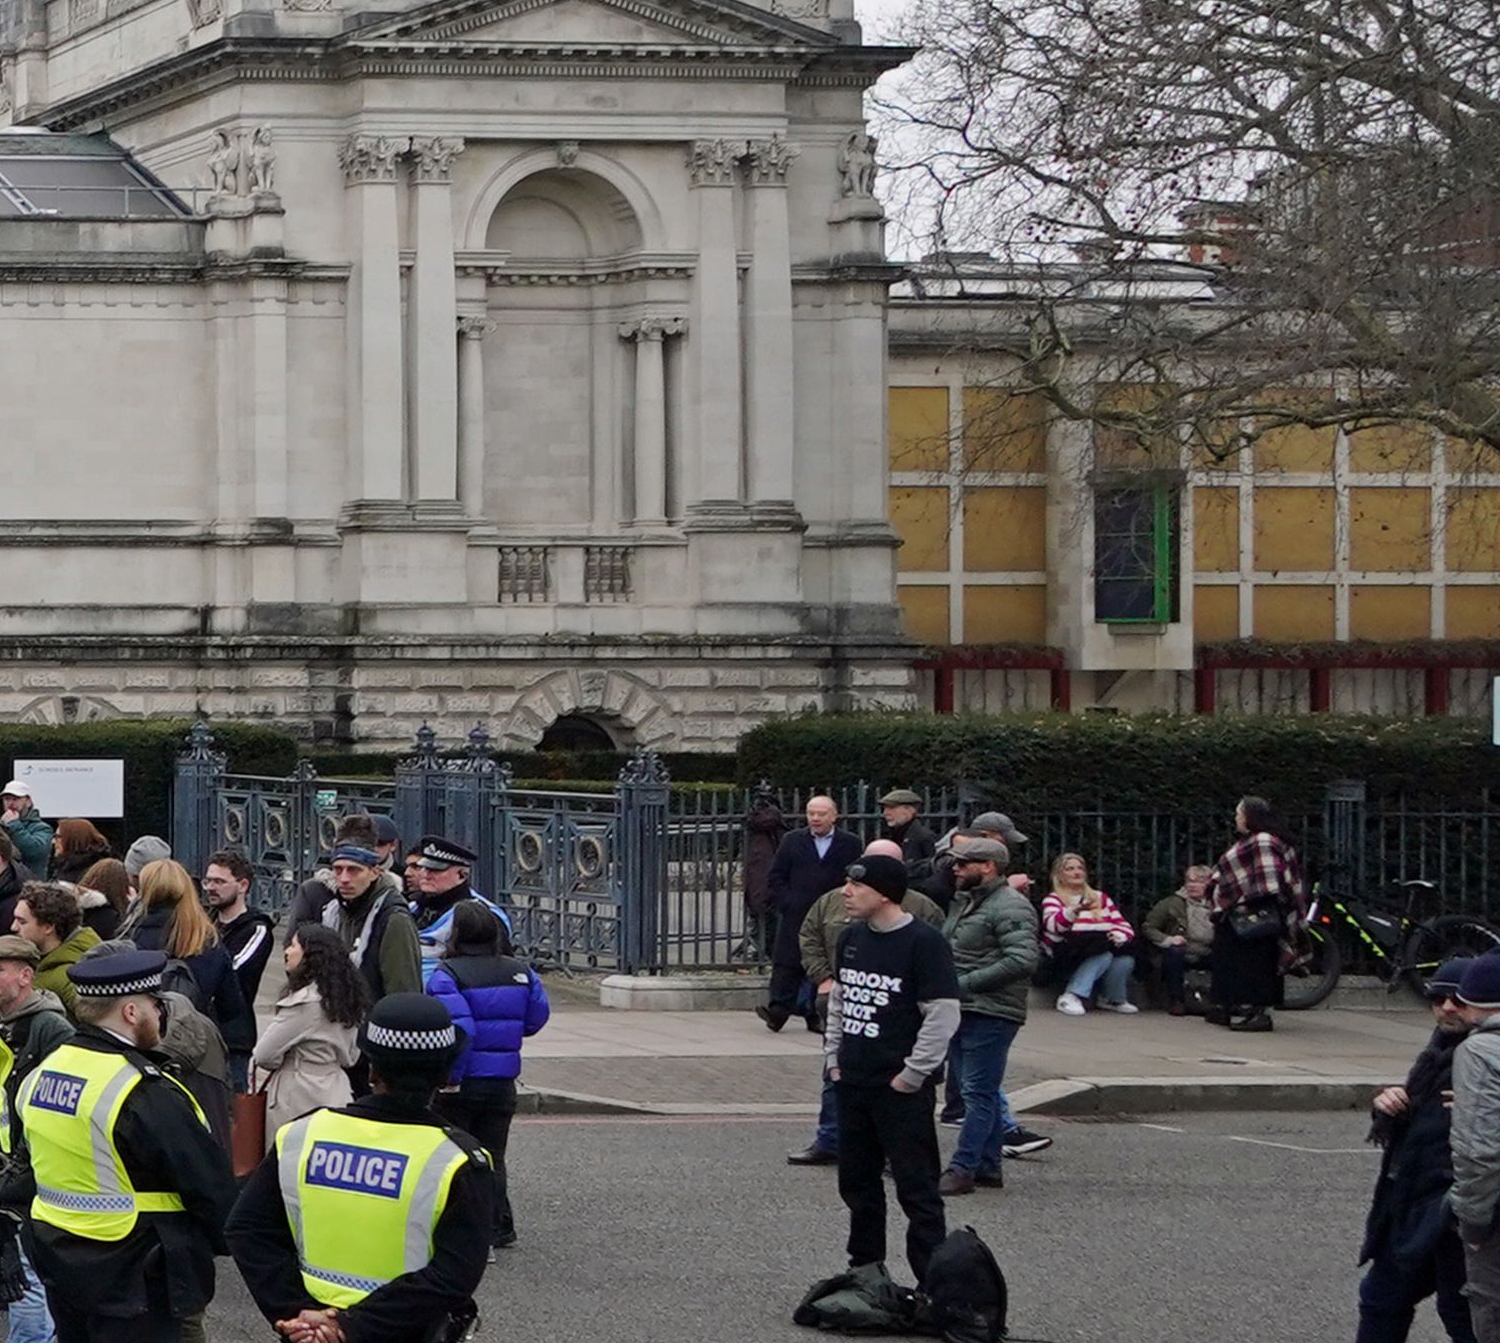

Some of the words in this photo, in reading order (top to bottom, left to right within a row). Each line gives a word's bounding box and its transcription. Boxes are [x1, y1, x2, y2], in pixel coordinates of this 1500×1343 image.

[843, 1002, 876, 1021] NOT
[35, 1075, 82, 1111] POLICE
[310, 1147, 400, 1190] POLICE
